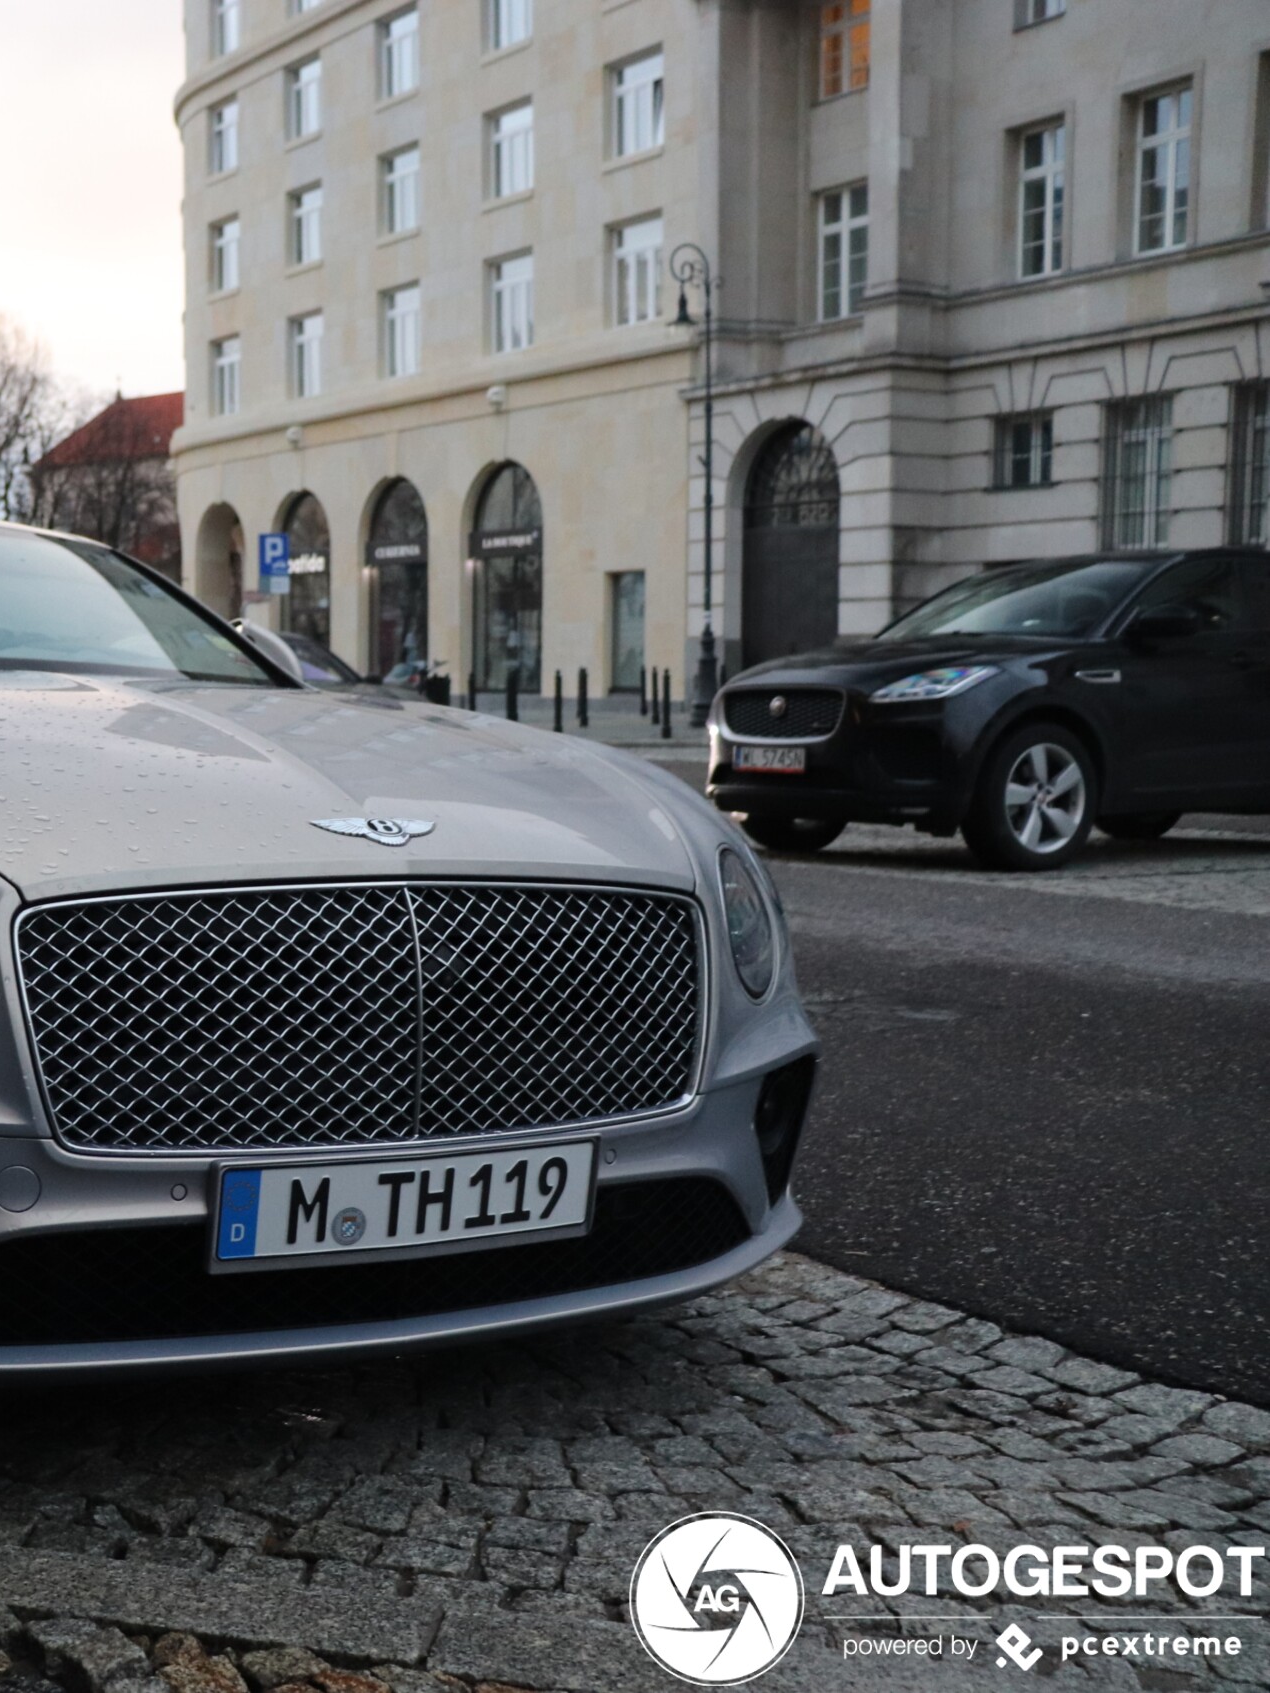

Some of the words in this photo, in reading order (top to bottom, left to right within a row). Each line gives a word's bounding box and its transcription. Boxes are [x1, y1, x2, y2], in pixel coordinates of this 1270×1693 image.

[264, 536, 284, 564] P
[286, 1176, 331, 1245] M
[230, 1223, 245, 1243] D
